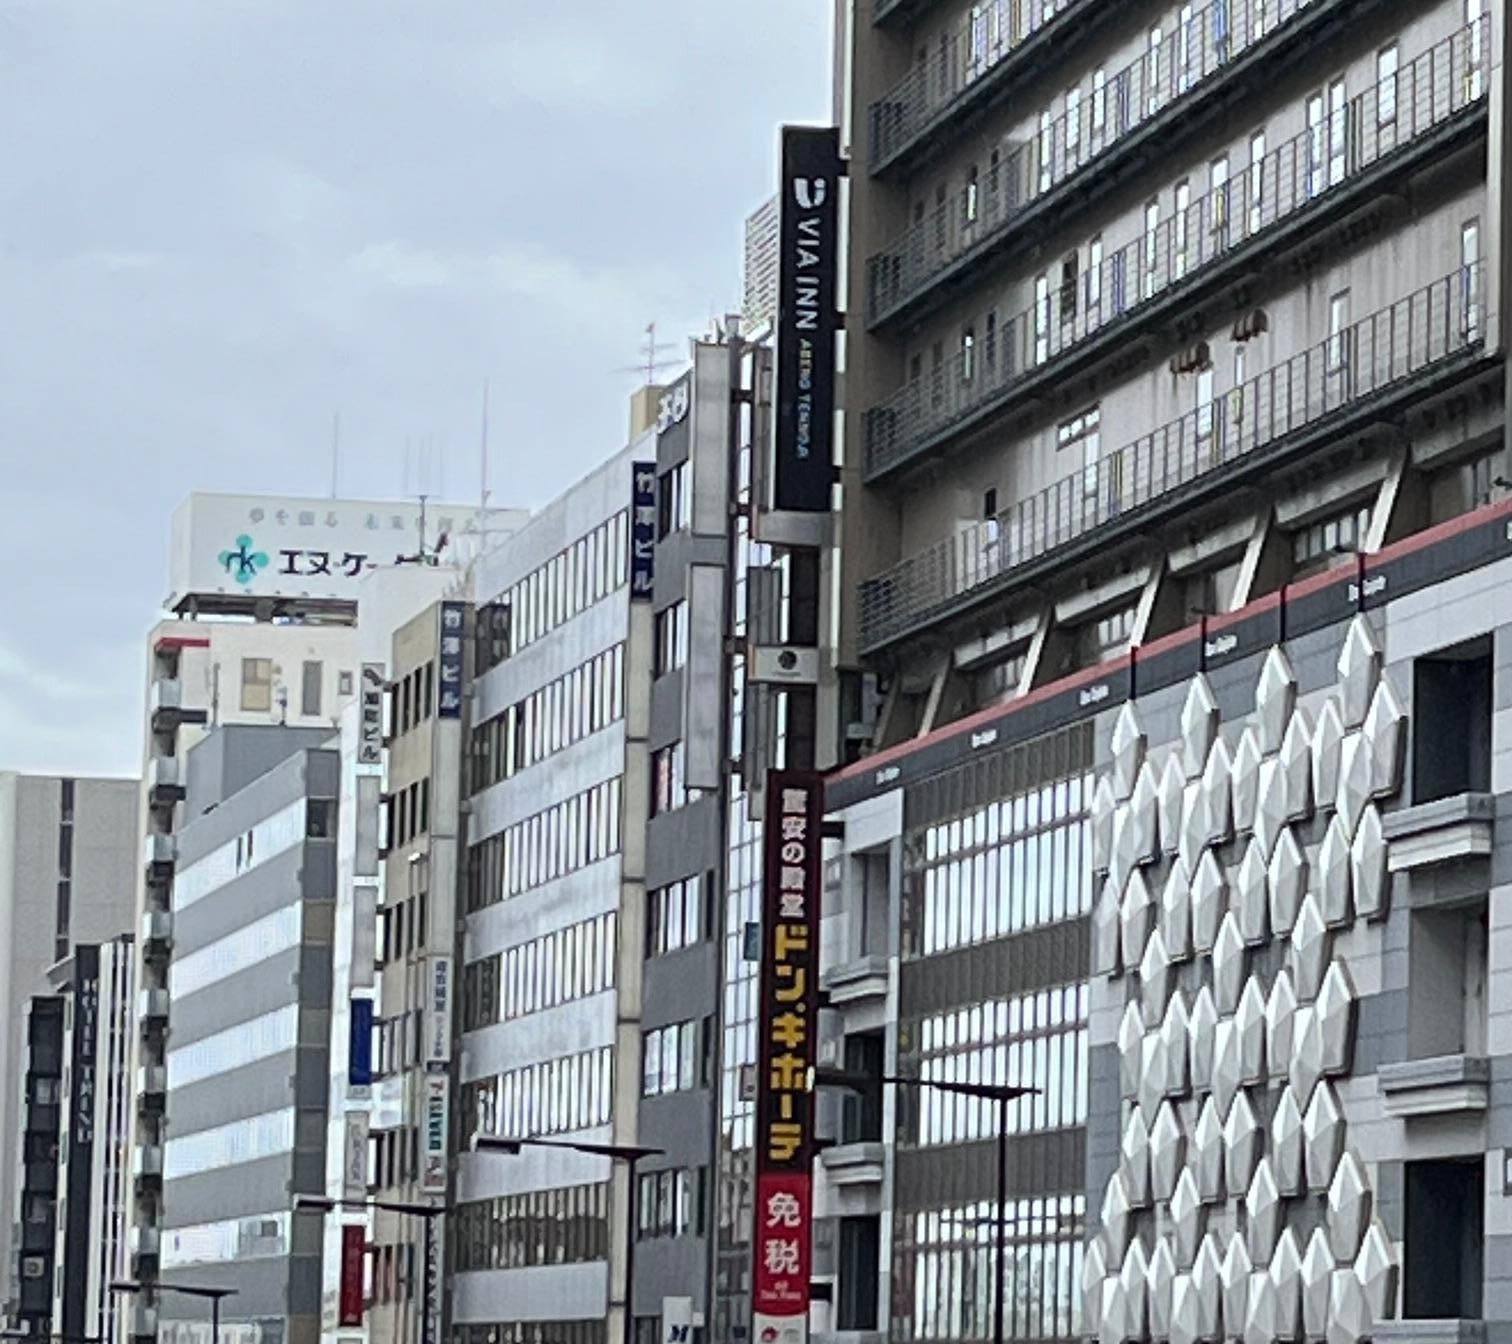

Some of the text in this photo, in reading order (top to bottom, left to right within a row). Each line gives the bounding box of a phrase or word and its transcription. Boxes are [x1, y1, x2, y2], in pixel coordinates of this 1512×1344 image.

[794, 216, 821, 330] VIA INN
[769, 923, 809, 1161] ドン・キホーテ
[765, 1191, 801, 1275] 免税
